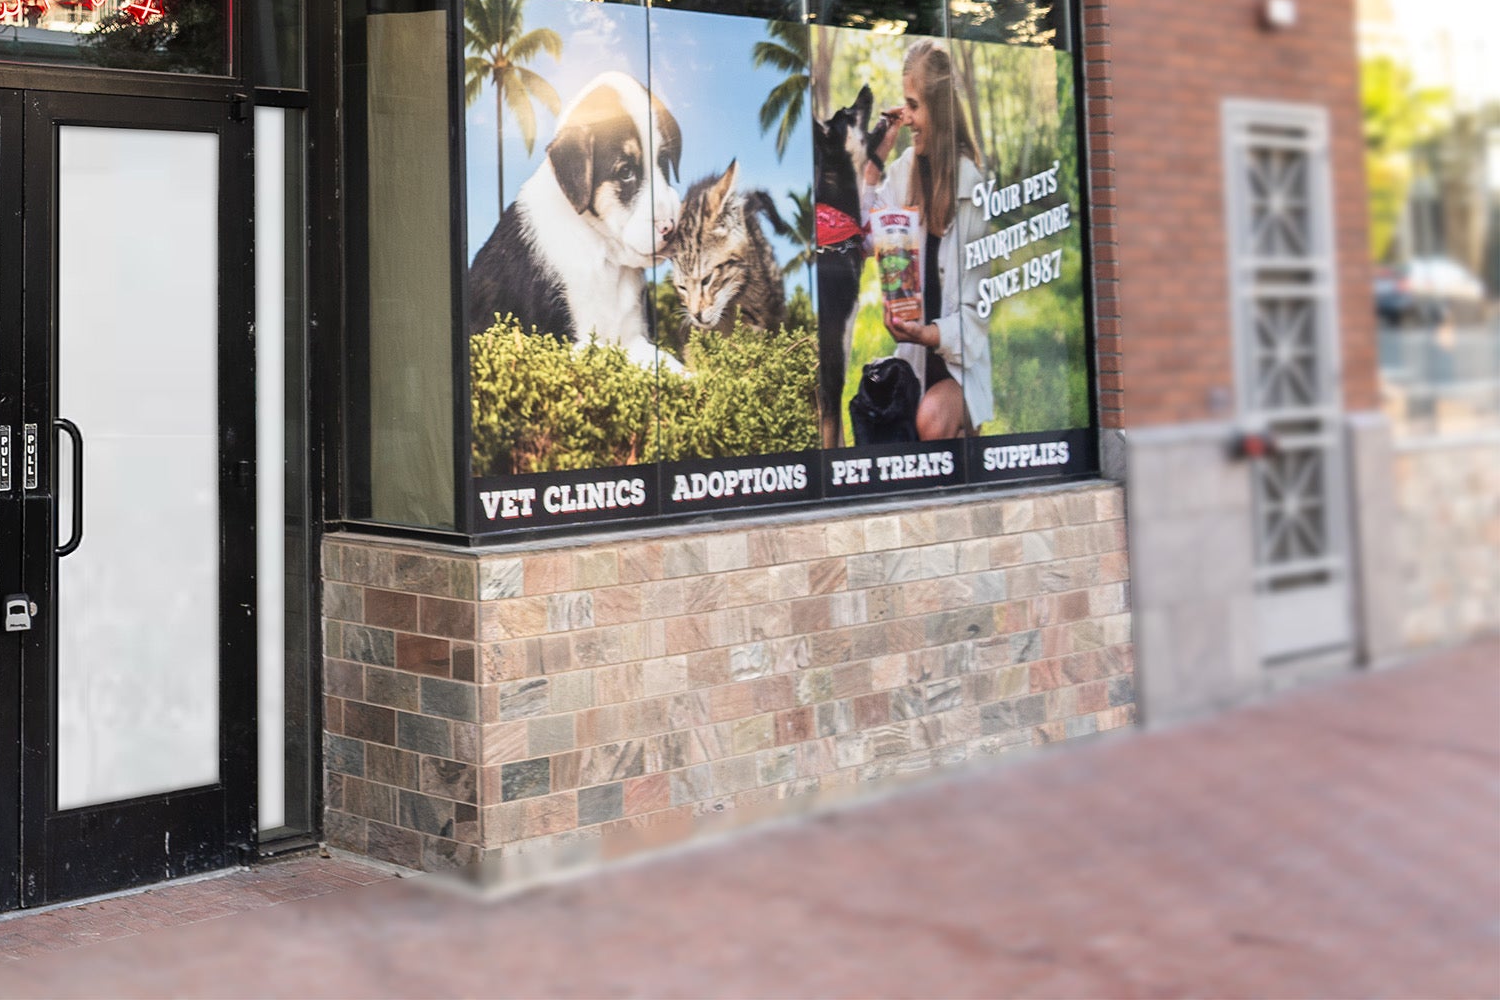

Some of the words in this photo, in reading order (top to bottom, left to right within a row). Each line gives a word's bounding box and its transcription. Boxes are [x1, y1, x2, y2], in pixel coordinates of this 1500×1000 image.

[972, 179, 1022, 221] YOUR
[964, 220, 1029, 270] FAVORITE
[1029, 202, 1071, 242] STORE
[977, 267, 1021, 318] SINCE
[1022, 248, 1062, 291] 1987
[27, 434, 35, 475] PULL
[831, 458, 872, 485] PET
[876, 451, 955, 481] TREATS
[983, 441, 1070, 471] SUPPLIES
[479, 488, 536, 520] VET
[542, 478, 647, 514] CLINICS
[671, 464, 808, 502] ADOPTIONS
